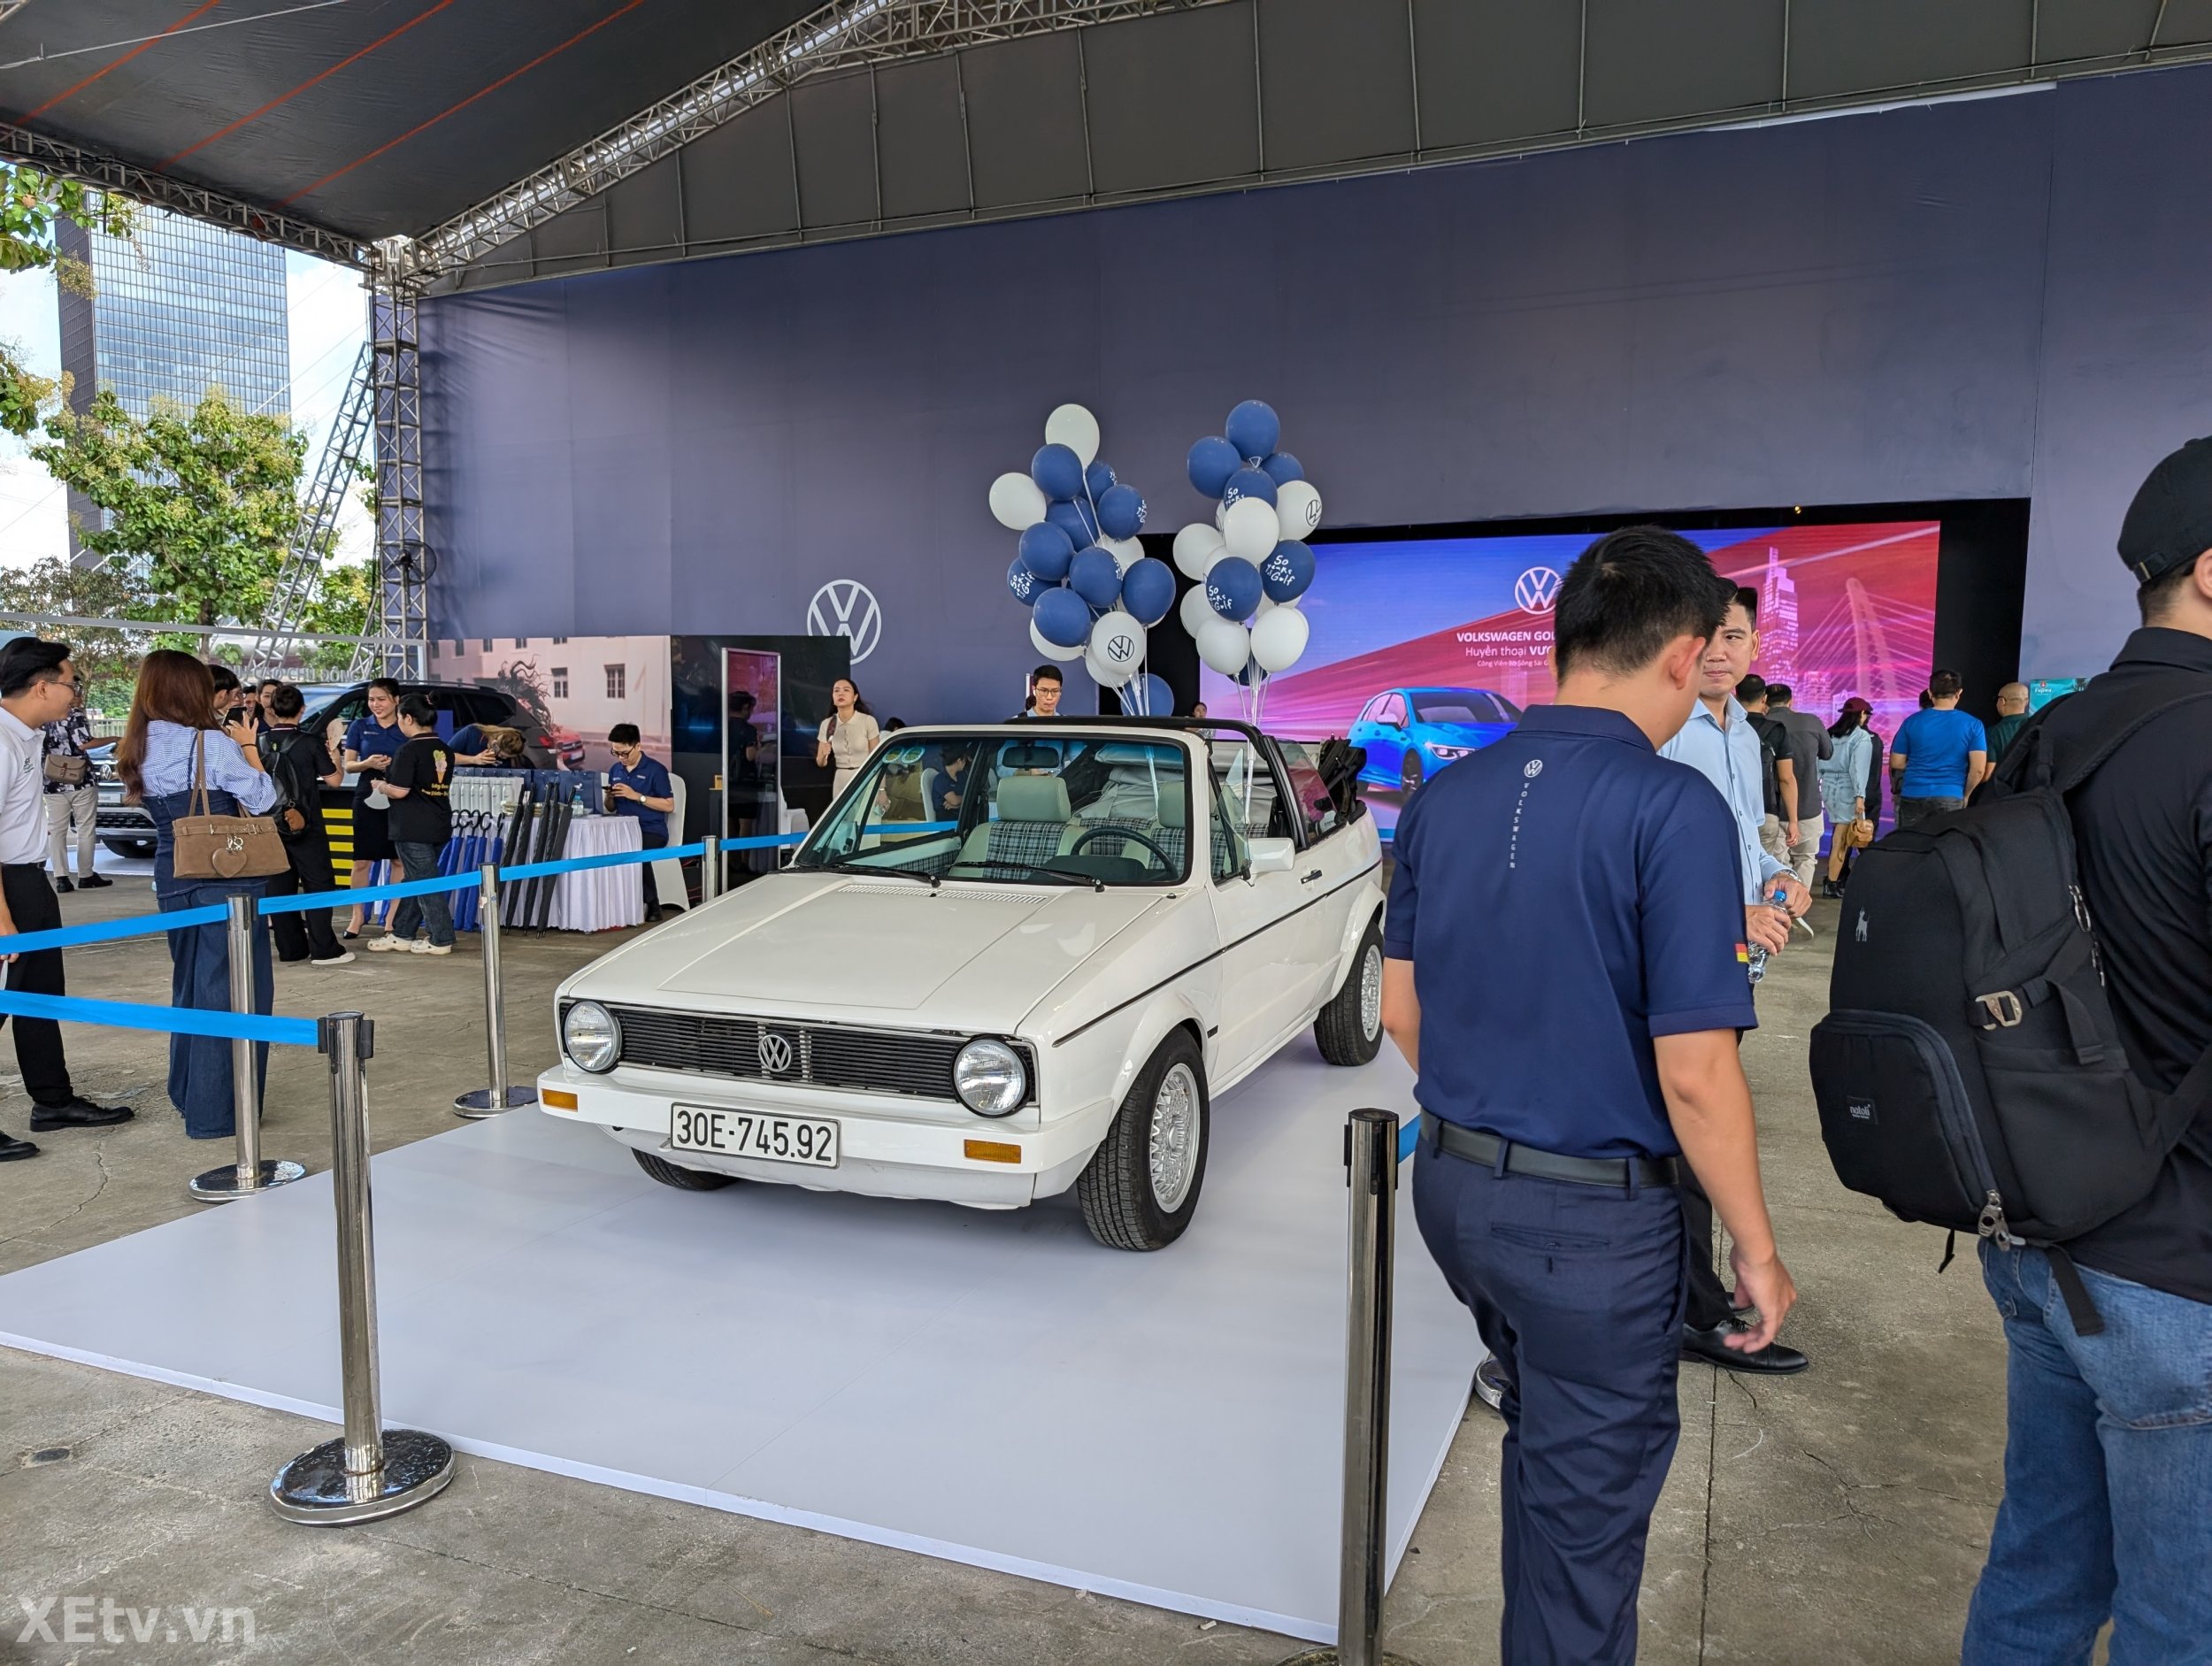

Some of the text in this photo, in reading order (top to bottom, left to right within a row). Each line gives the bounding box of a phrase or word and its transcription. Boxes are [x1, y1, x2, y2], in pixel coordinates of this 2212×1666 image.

[1227, 488, 1239, 499] 50
[1274, 555, 1289, 565] 50
[1010, 575, 1018, 589] 50
[1271, 572, 1295, 586] Golf
[1209, 585, 1219, 596] 50
[1214, 598, 1233, 610] Golf
[1456, 632, 1531, 642] VOLKSWAGEN
[1465, 644, 1498, 658] Huyền
[1501, 646, 1526, 657] thoại
[1509, 782, 1530, 869] VOLKSWAGEN
[677, 1110, 832, 1162] 30E-745.92
